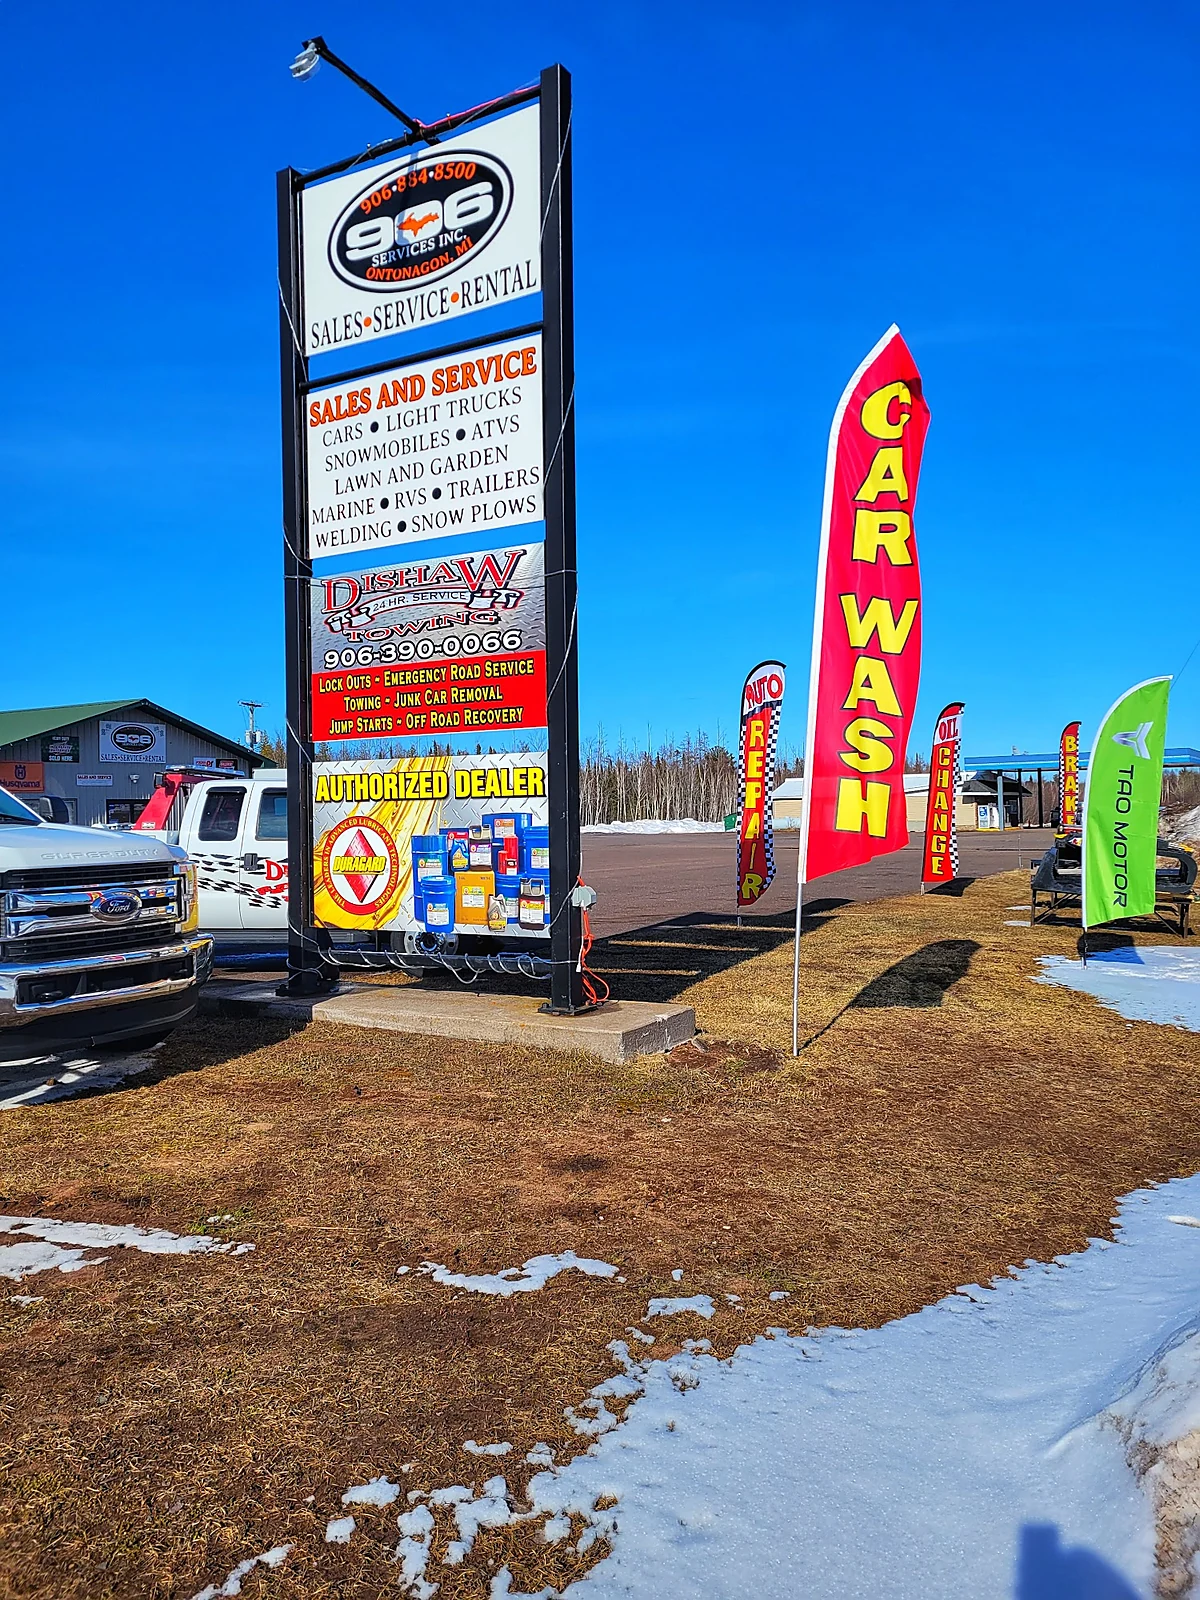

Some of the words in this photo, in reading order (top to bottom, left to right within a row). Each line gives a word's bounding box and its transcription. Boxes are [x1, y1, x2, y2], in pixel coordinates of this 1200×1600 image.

[346, 182, 494, 261] 906
[372, 237, 435, 267] SERVICES
[438, 228, 468, 247] INC.
[456, 236, 474, 258] MI
[310, 388, 371, 427] SALES
[377, 374, 425, 408] AND
[432, 347, 537, 396] SERVICE
[322, 422, 363, 447] CARS
[386, 404, 440, 432] LIGHT
[446, 386, 522, 418] TRUCKS
[325, 430, 450, 472] SNOWMOBILES
[472, 414, 520, 440] ATVS
[312, 498, 375, 525] MARINE
[395, 488, 427, 510] RVS
[448, 466, 540, 500] TRAILERS
[335, 470, 382, 496] LAWN
[388, 462, 424, 484] AND
[430, 444, 508, 476] GARDEN
[852, 380, 913, 566] CAR
[316, 521, 392, 548] WELDING
[412, 508, 464, 533] SNOW
[472, 495, 536, 522] PLOWS
[322, 550, 526, 614] DISHAW
[372, 600, 386, 612] 24
[388, 594, 409, 608] HR.
[412, 591, 467, 602] SERVICE
[324, 629, 522, 669] 906-390-0066
[342, 610, 501, 642] TOWING
[745, 673, 784, 709] AUTO
[836, 592, 919, 838] WASH
[116, 734, 151, 744] 906
[938, 717, 958, 742] OIL
[316, 770, 448, 802] AUTHORIZED
[454, 767, 546, 798] DEALER
[742, 720, 764, 900] REPAIR
[931, 746, 951, 875] CHANGE
[1116, 764, 1134, 814] TAO
[333, 856, 387, 872] DURAGARD
[1113, 821, 1129, 908] MOTOR
[107, 900, 131, 913] Ford
